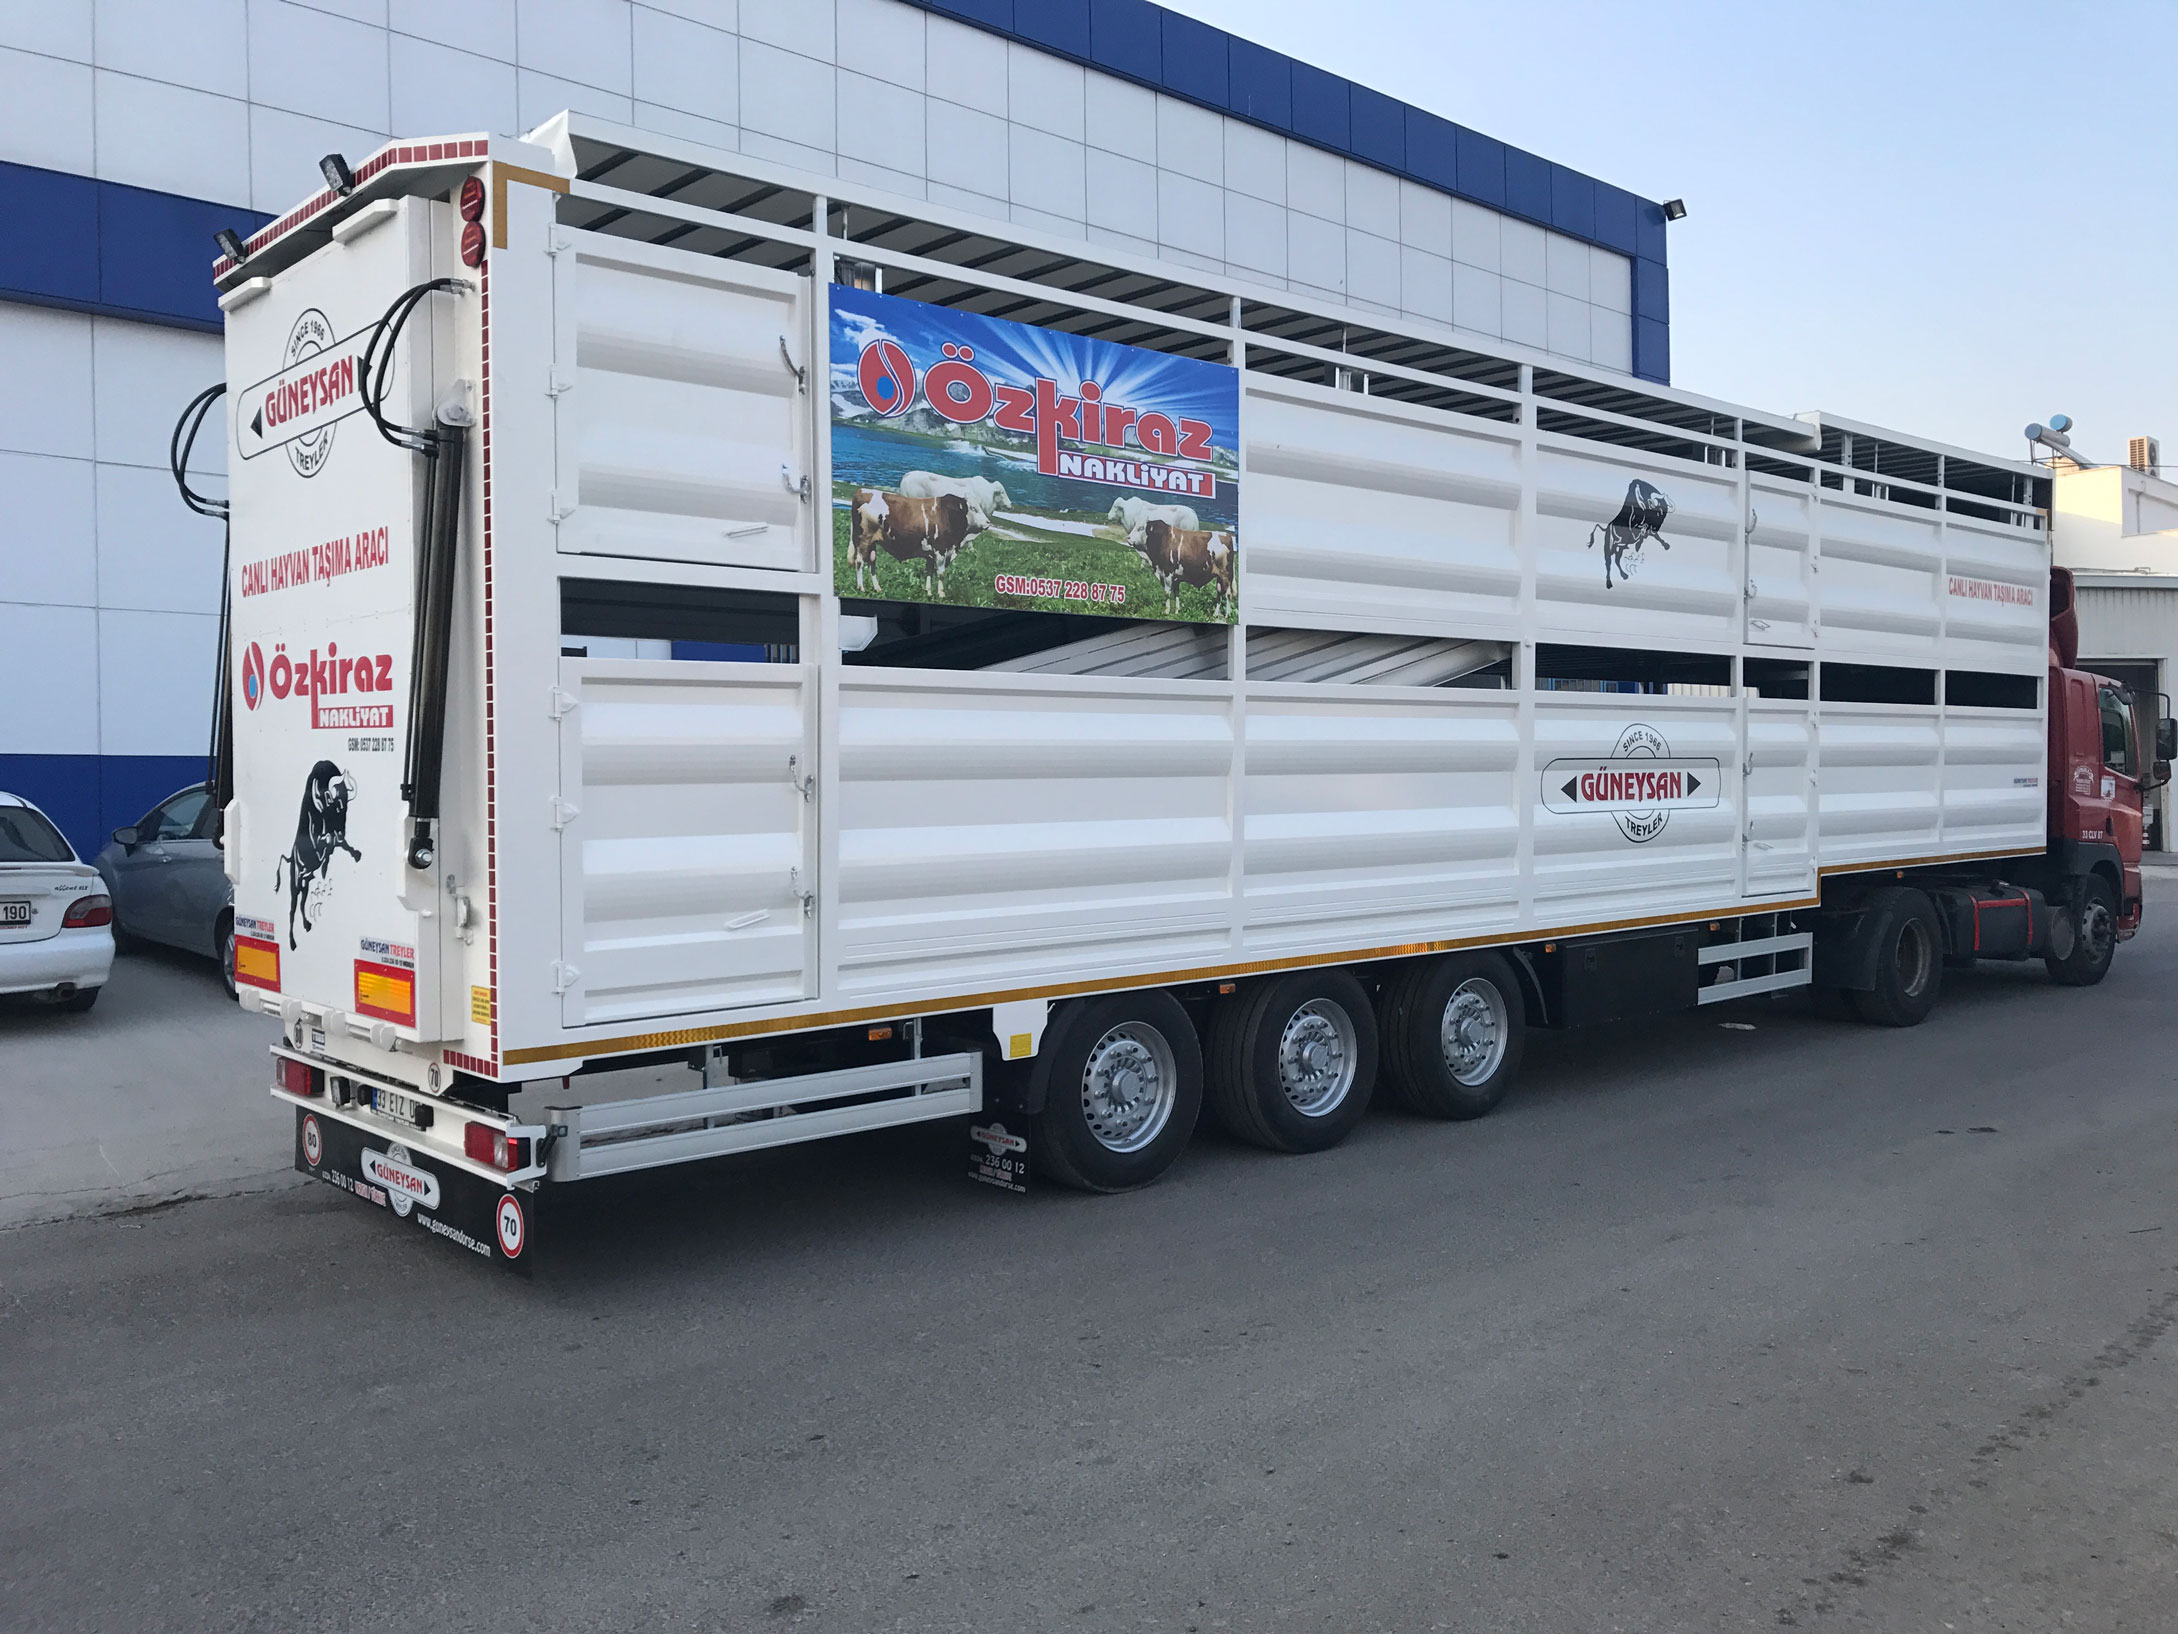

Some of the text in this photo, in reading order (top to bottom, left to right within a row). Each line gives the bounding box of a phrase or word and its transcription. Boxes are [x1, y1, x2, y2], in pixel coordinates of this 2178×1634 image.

[291, 320, 325, 356] SINCE 1966
[265, 355, 353, 427] GÜNEYSAN
[923, 341, 1213, 475] Özkiraz
[295, 430, 329, 470] TREYLER
[242, 526, 389, 598] CANLI HAYVAN TAŞIMA ARACI
[995, 574, 1125, 603] GSM:0537 228 87 75
[1968, 580, 1992, 600] HAYVAN
[269, 641, 393, 728] Özkiraz
[1623, 731, 1661, 752] SINCE 1966
[1581, 766, 1682, 803] GÜNEYSAN
[1625, 812, 1663, 836] TREYLER
[3, 906, 27, 920] 190
[390, 944, 414, 960] TREYLER
[377, 1088, 386, 1108] 33
[985, 1154, 1000, 1168] 236
[1015, 1162, 1025, 1174] 12
[377, 1163, 423, 1195] GÜNEYSAN
[503, 1215, 517, 1236] 70
